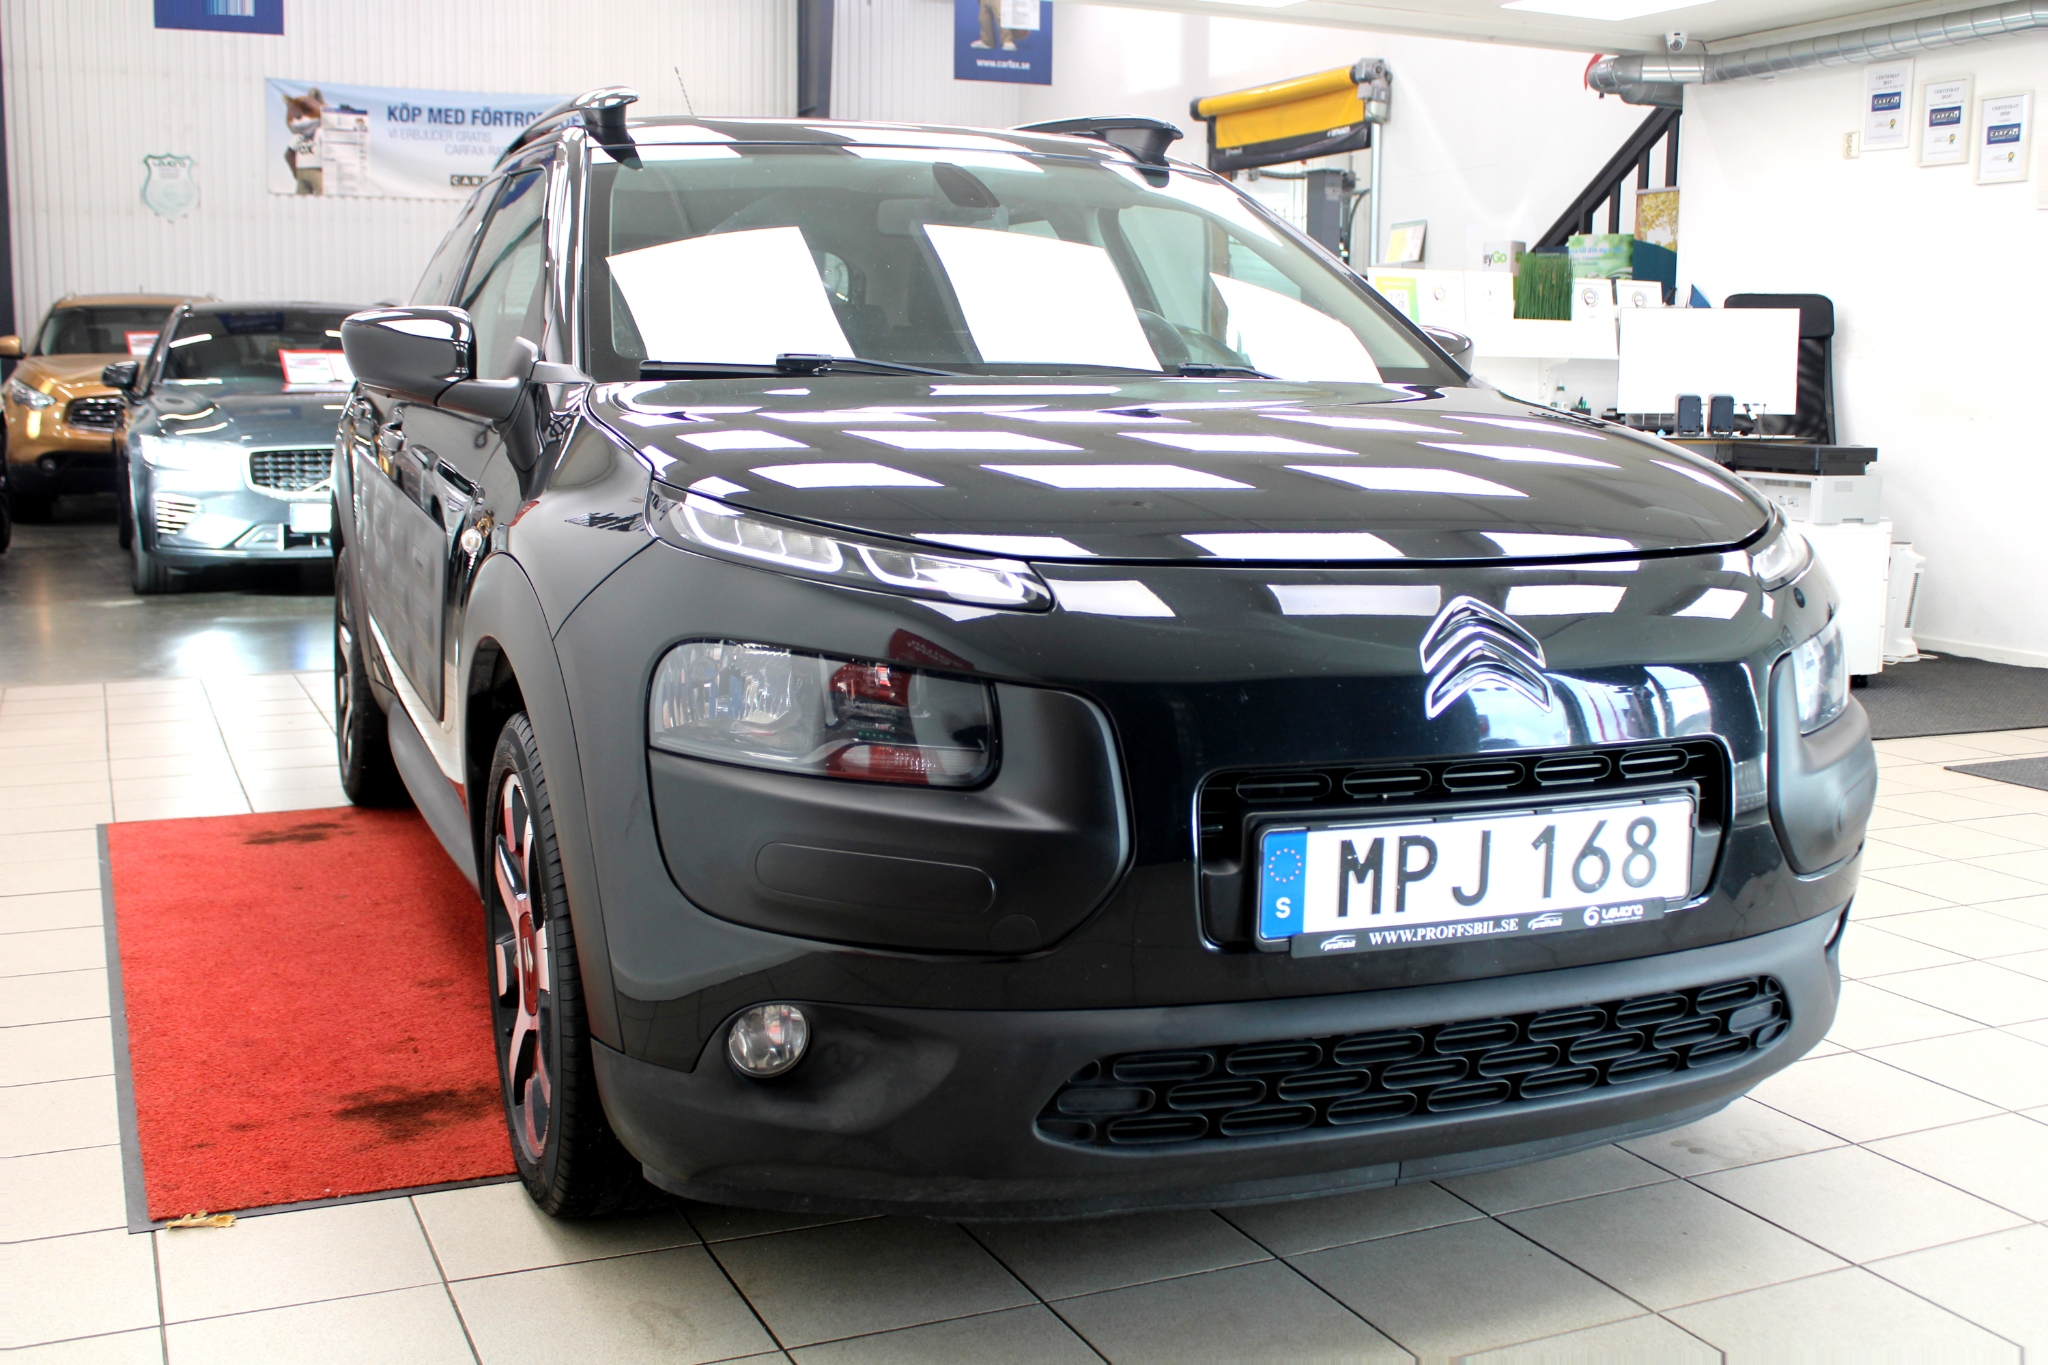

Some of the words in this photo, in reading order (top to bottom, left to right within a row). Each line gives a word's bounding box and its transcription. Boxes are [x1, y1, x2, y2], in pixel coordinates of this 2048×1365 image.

[976, 59, 1030, 70] www.carfax.se
[387, 103, 422, 123] KÖP
[427, 107, 465, 125] MED
[471, 106, 580, 130] FÖRTRODE
[388, 129, 398, 139] VI
[401, 129, 454, 141] ERBJUDER
[456, 131, 491, 142] GRATIS
[1337, 829, 1492, 917] MPJ
[1531, 816, 1657, 899] 168
[1275, 896, 1291, 919] S
[1324, 940, 1356, 951] proffsbil
[1368, 918, 1519, 946] WWW.PROFFSBIL.SE
